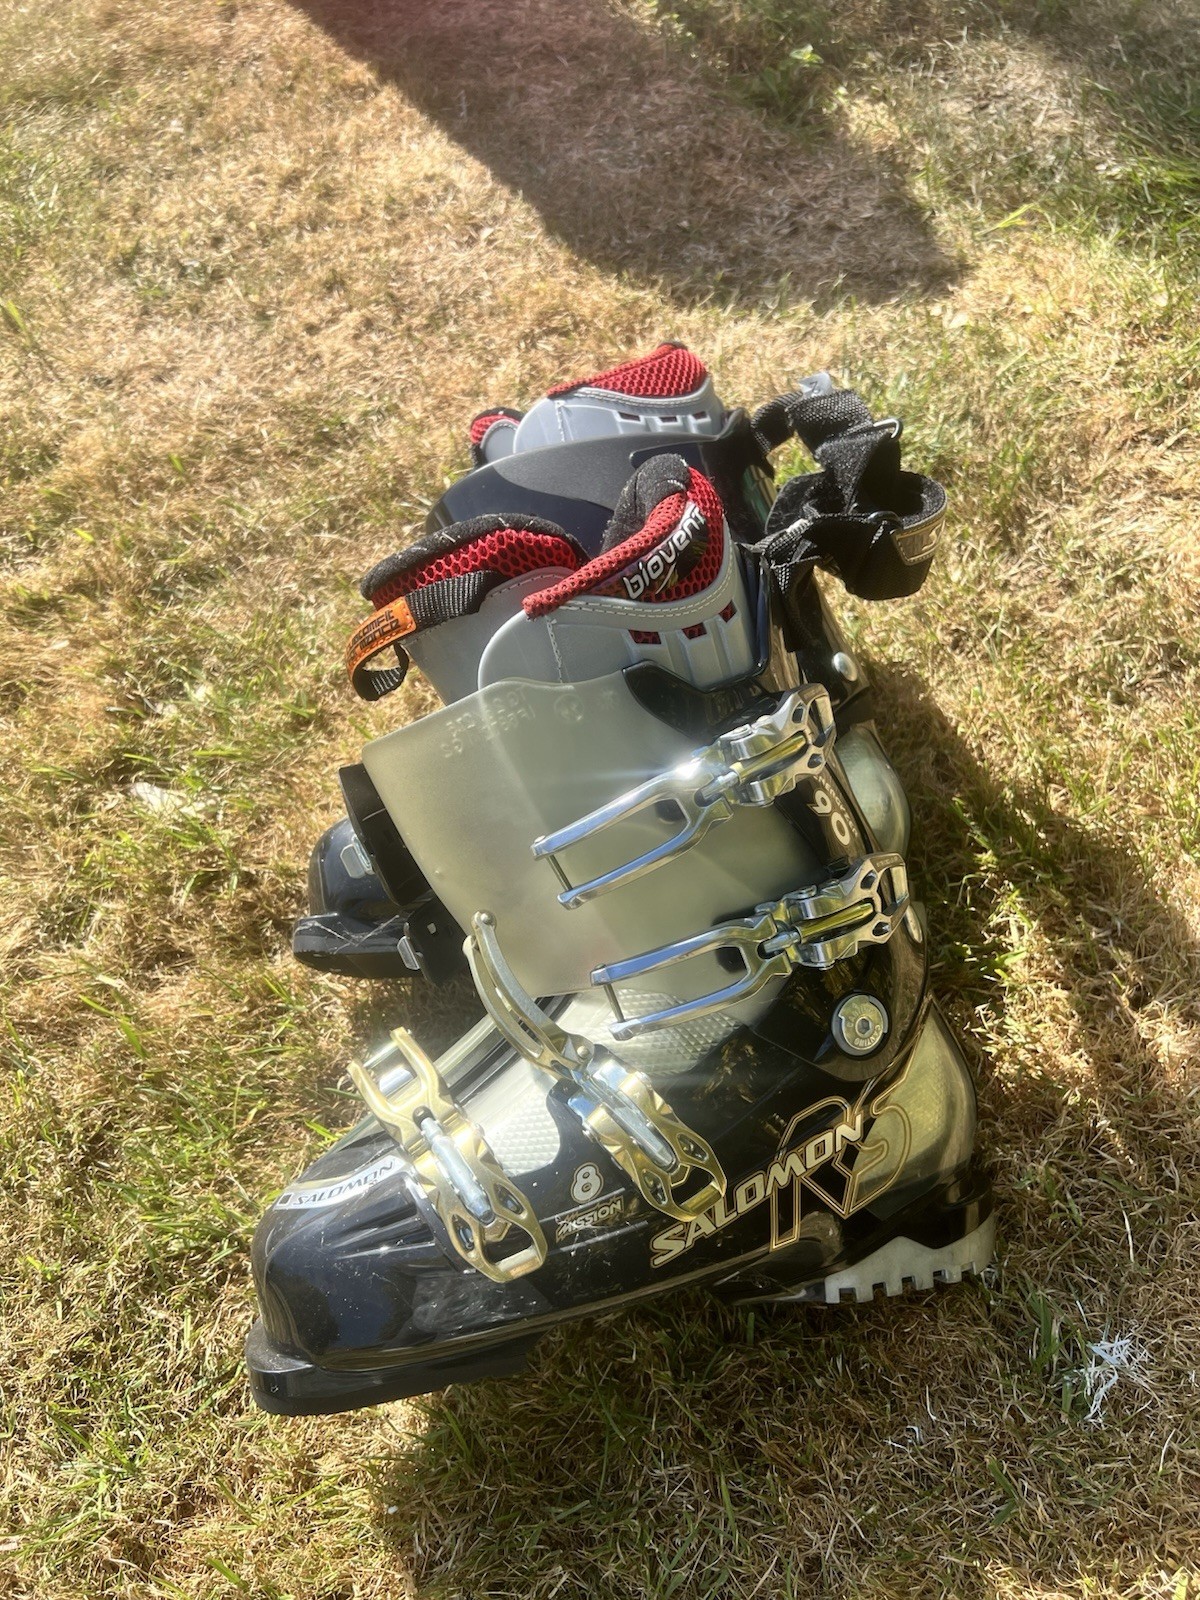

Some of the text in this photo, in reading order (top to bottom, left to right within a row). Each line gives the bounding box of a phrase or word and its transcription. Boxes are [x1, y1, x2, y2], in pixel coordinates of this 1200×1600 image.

[623, 506, 706, 599] biovent
[812, 790, 851, 846] 90
[813, 775, 858, 838] NERGYZER
[293, 1160, 395, 1206] SALOMON
[572, 1163, 603, 1203] 8
[652, 1113, 863, 1267] SALOMON
